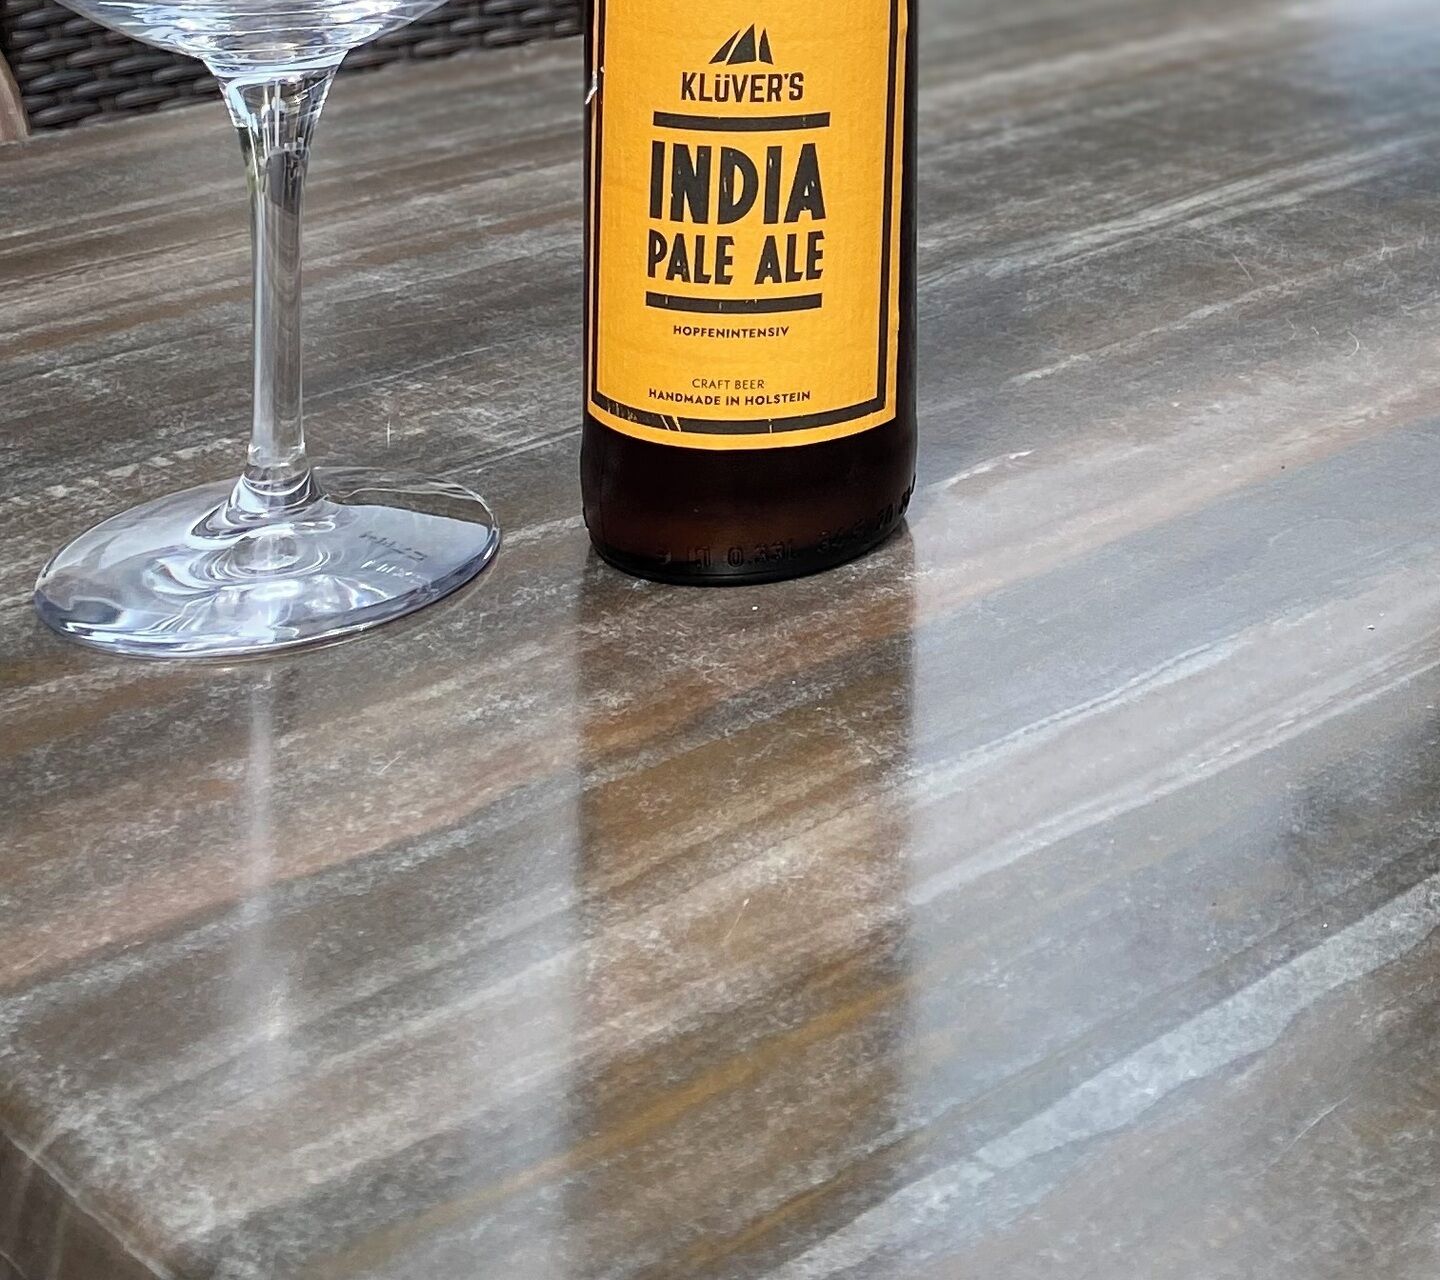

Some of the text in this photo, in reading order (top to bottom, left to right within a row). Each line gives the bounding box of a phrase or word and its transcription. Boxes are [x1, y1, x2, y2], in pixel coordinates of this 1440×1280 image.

[649, 140, 827, 225] INDIA
[647, 228, 825, 285] PALE ALE
[673, 325, 790, 339] HOPFENINTENSIV
[692, 378, 765, 390] CRAFT BEER
[648, 387, 811, 406] HANDMADE IN HOLSTEIN
